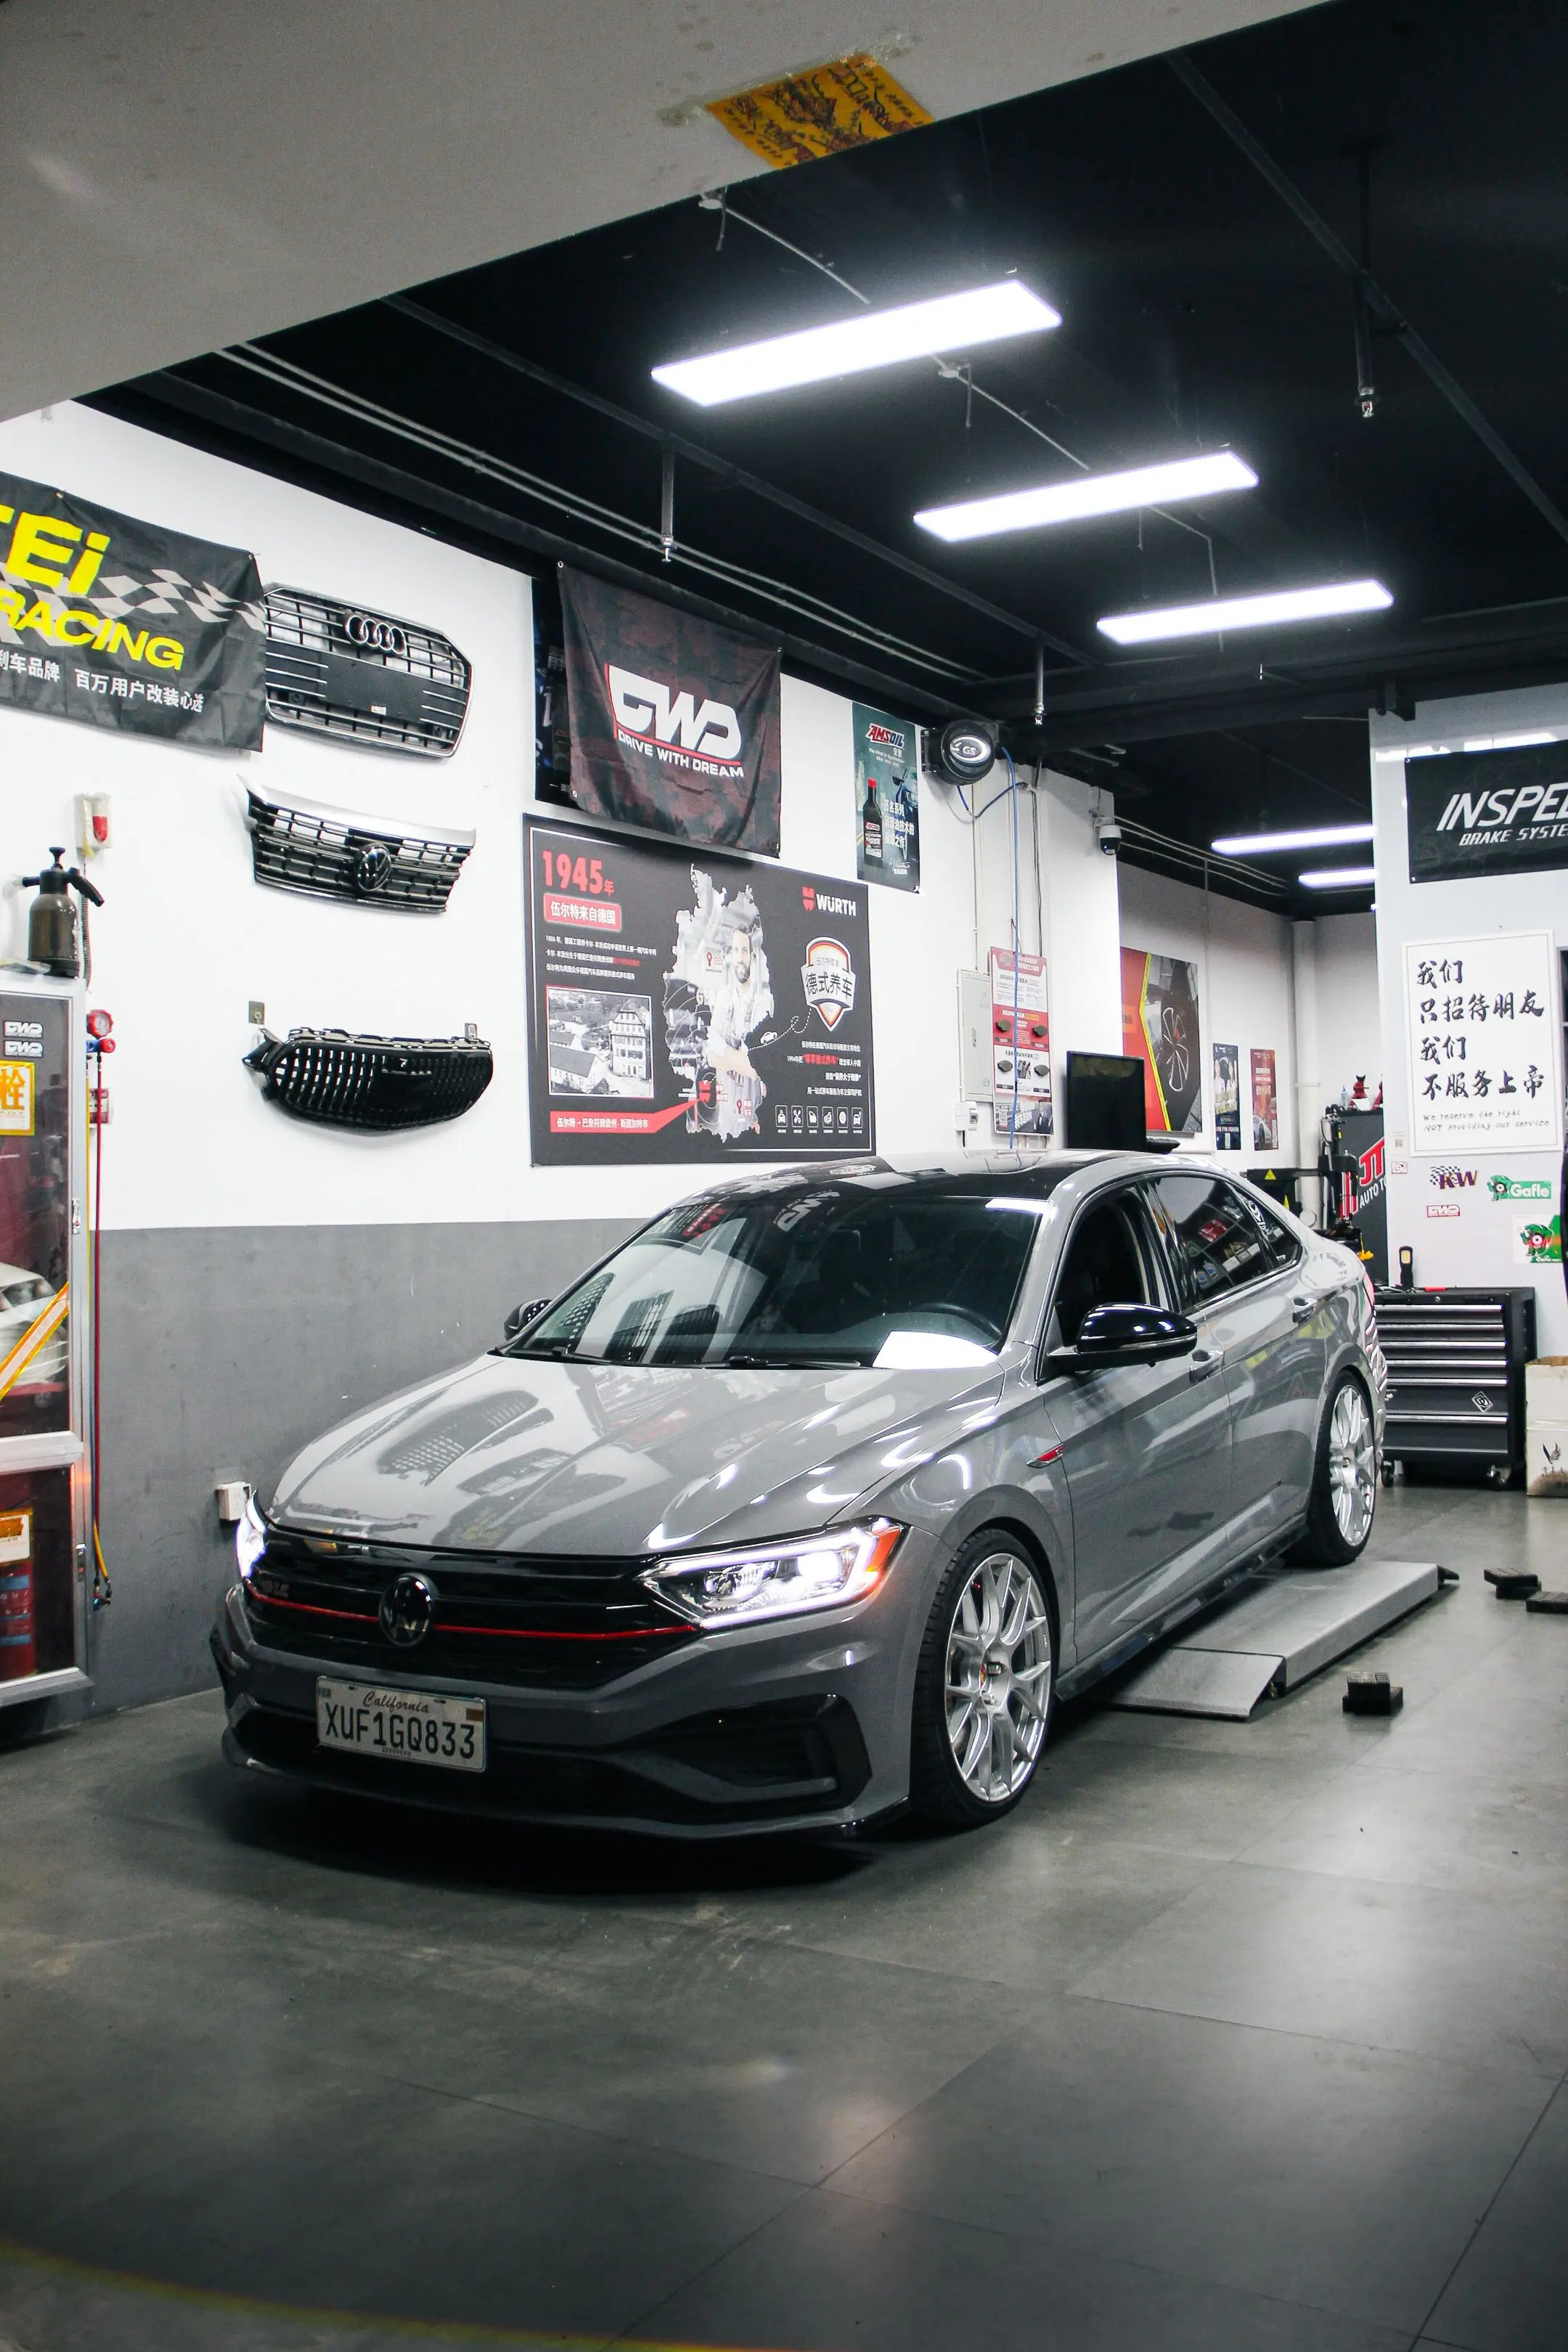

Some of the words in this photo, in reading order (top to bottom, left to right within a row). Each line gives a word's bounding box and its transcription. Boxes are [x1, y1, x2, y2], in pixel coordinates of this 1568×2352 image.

[0, 504, 110, 595] Ei
[0, 589, 185, 670] RACING
[868, 724, 904, 748] AMSOIL
[618, 729, 653, 756] DRIVE
[656, 746, 689, 768] WITH
[692, 758, 744, 777] DREAM
[1458, 829, 1514, 846] BRAKE
[550, 900, 616, 925] 伍尔特来自德国
[805, 971, 853, 1000] 德式养车
[1417, 958, 1463, 989] 我们
[1420, 989, 1545, 1024] 只招待朋友
[1420, 1034, 1466, 1065] 我们
[1421, 1064, 1545, 1101] 不服务上帝
[1424, 1124, 1442, 1132] NOT
[1360, 1183, 1379, 1209] AUTO
[362, 1691, 430, 1714] California
[324, 1702, 475, 1759] XUF1GQ833
